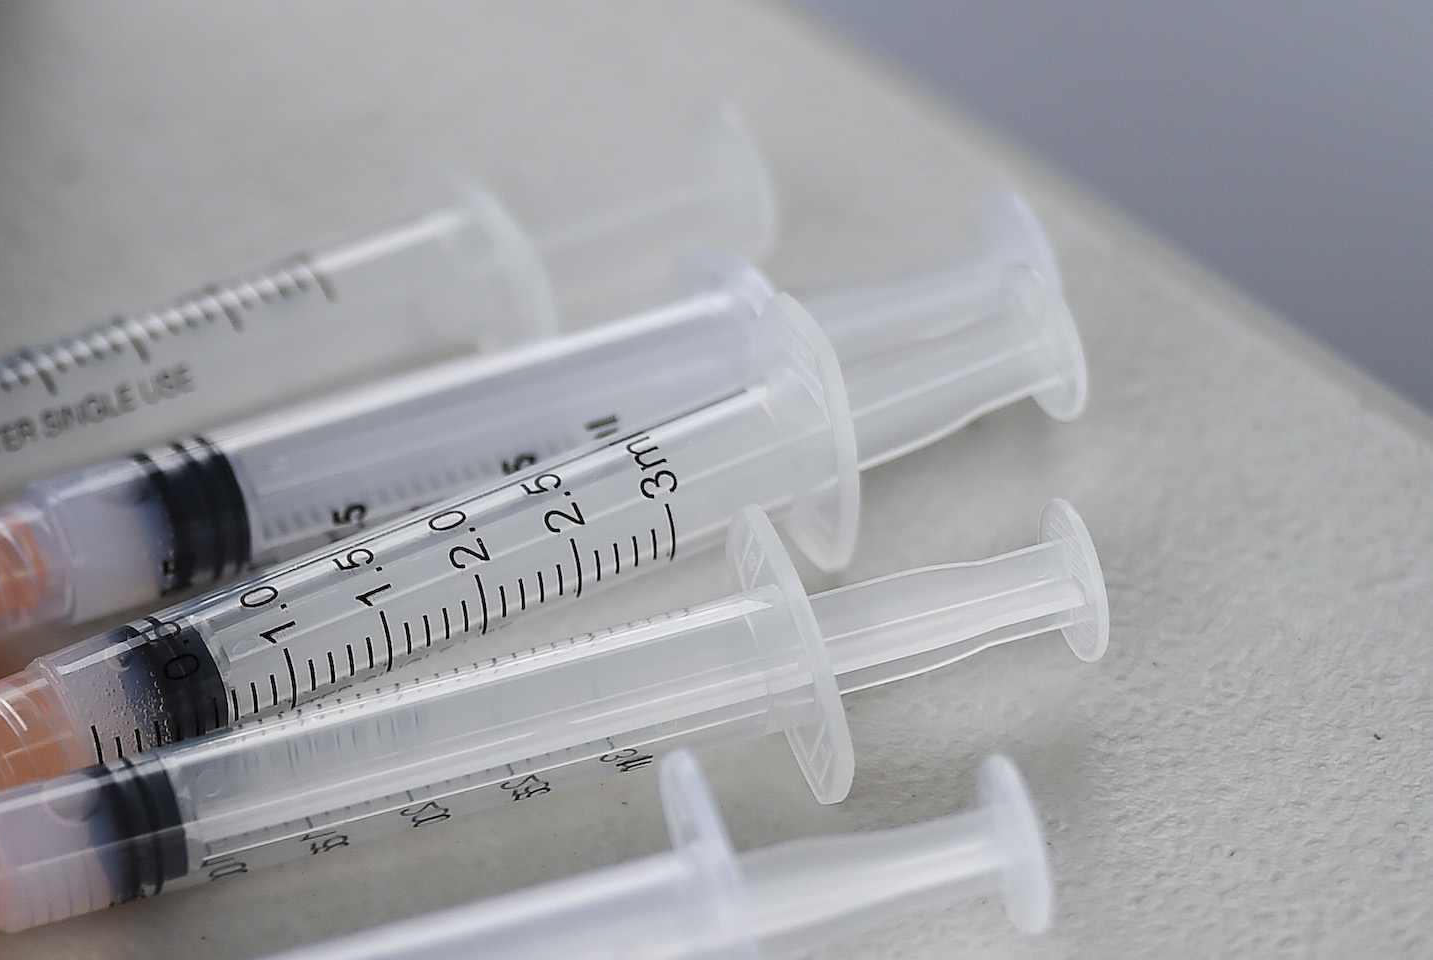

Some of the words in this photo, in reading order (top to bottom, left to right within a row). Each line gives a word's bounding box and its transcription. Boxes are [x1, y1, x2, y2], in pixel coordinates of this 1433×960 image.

[39, 383, 142, 439] SINGLE
[136, 360, 197, 405] USE
[520, 473, 586, 533] 2.5
[428, 509, 491, 570] 2.0
[332, 548, 392, 608] 1.5
[239, 585, 296, 645] 1.0
